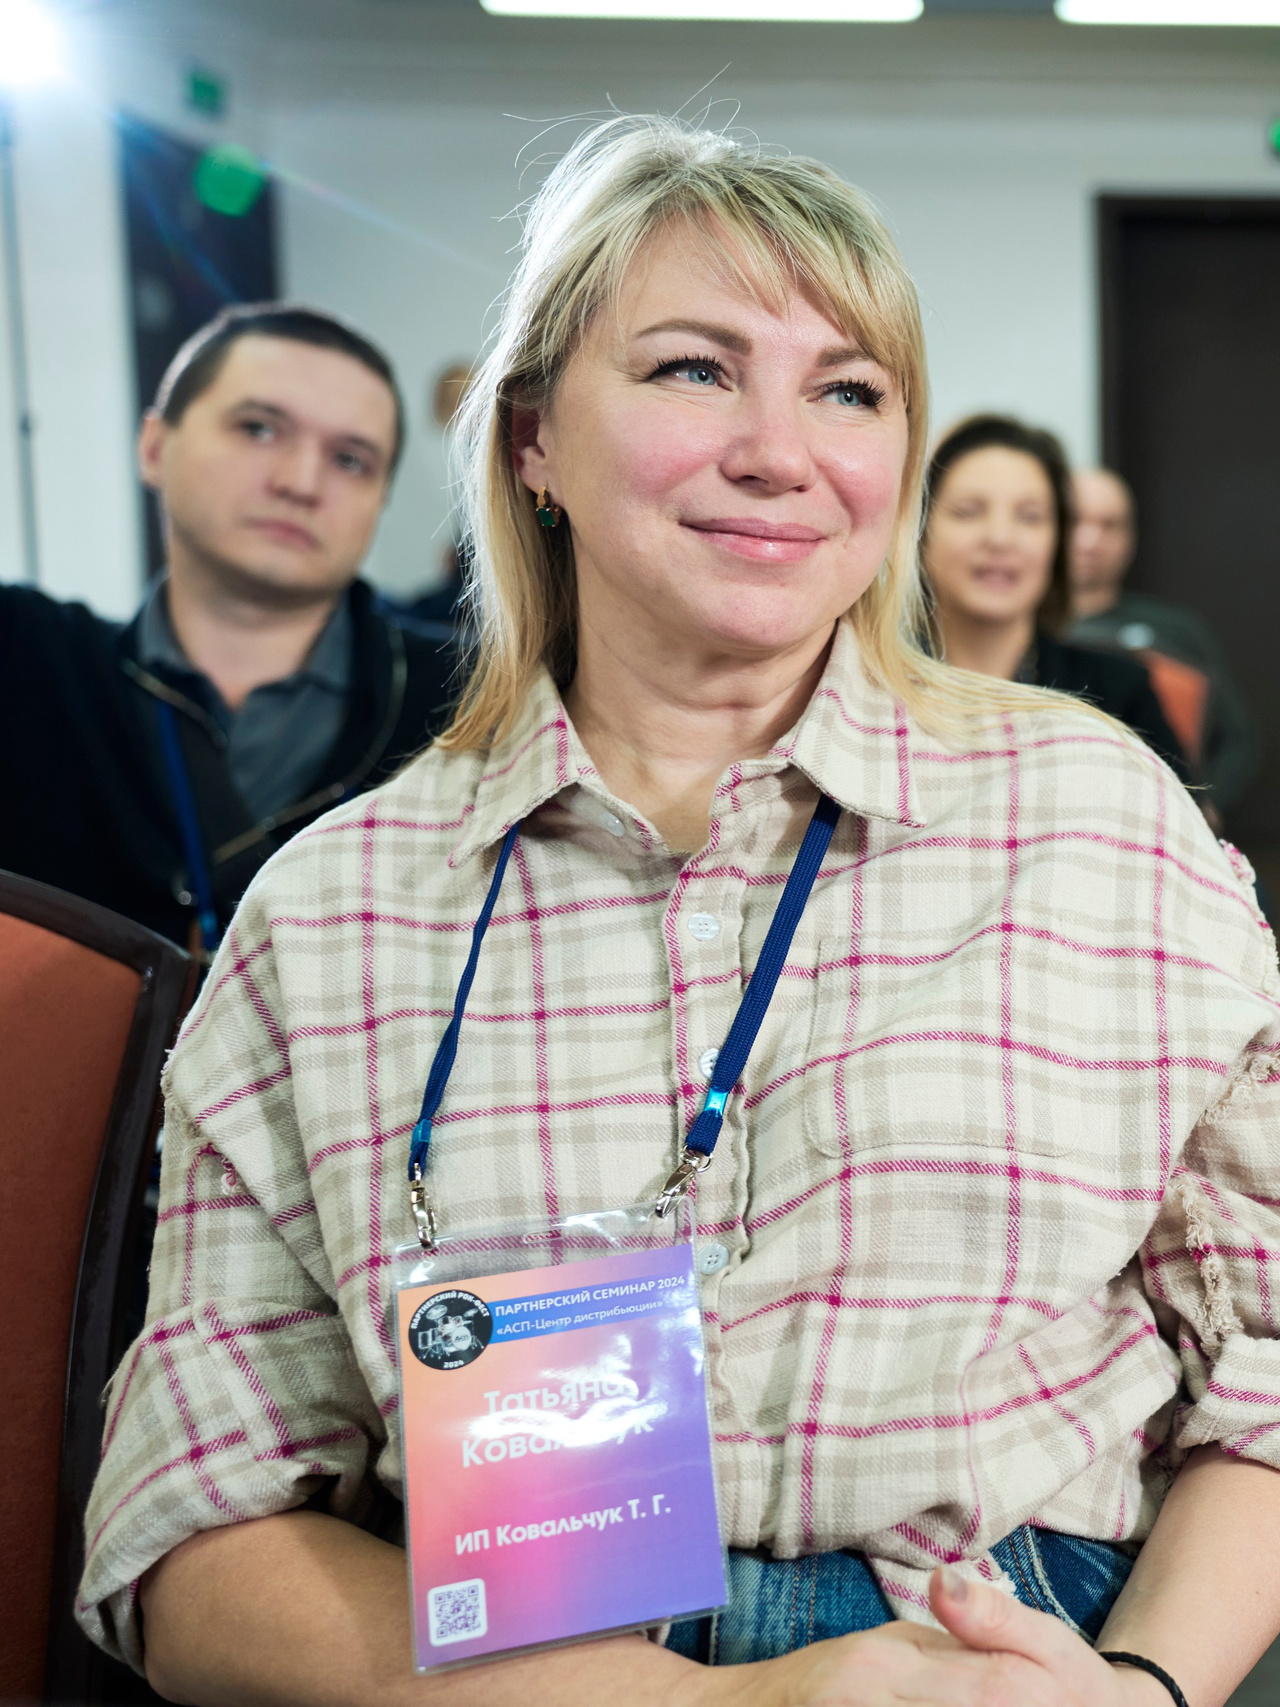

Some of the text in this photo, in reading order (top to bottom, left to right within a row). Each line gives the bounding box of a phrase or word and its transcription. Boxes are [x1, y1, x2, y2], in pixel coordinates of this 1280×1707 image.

[410, 1290, 490, 1330] ПАРТНЕРСКИЙ РОК-ФЕСТ
[495, 1275, 685, 1317] ПАРТНЕРСКИЙ СЕМИНАР 2024
[496, 1300, 664, 1336] «АСП-Центр дистрибьюции»
[443, 1360, 464, 1369] 2024
[455, 1493, 672, 1555] ИП Ковальчук Т. Г.
